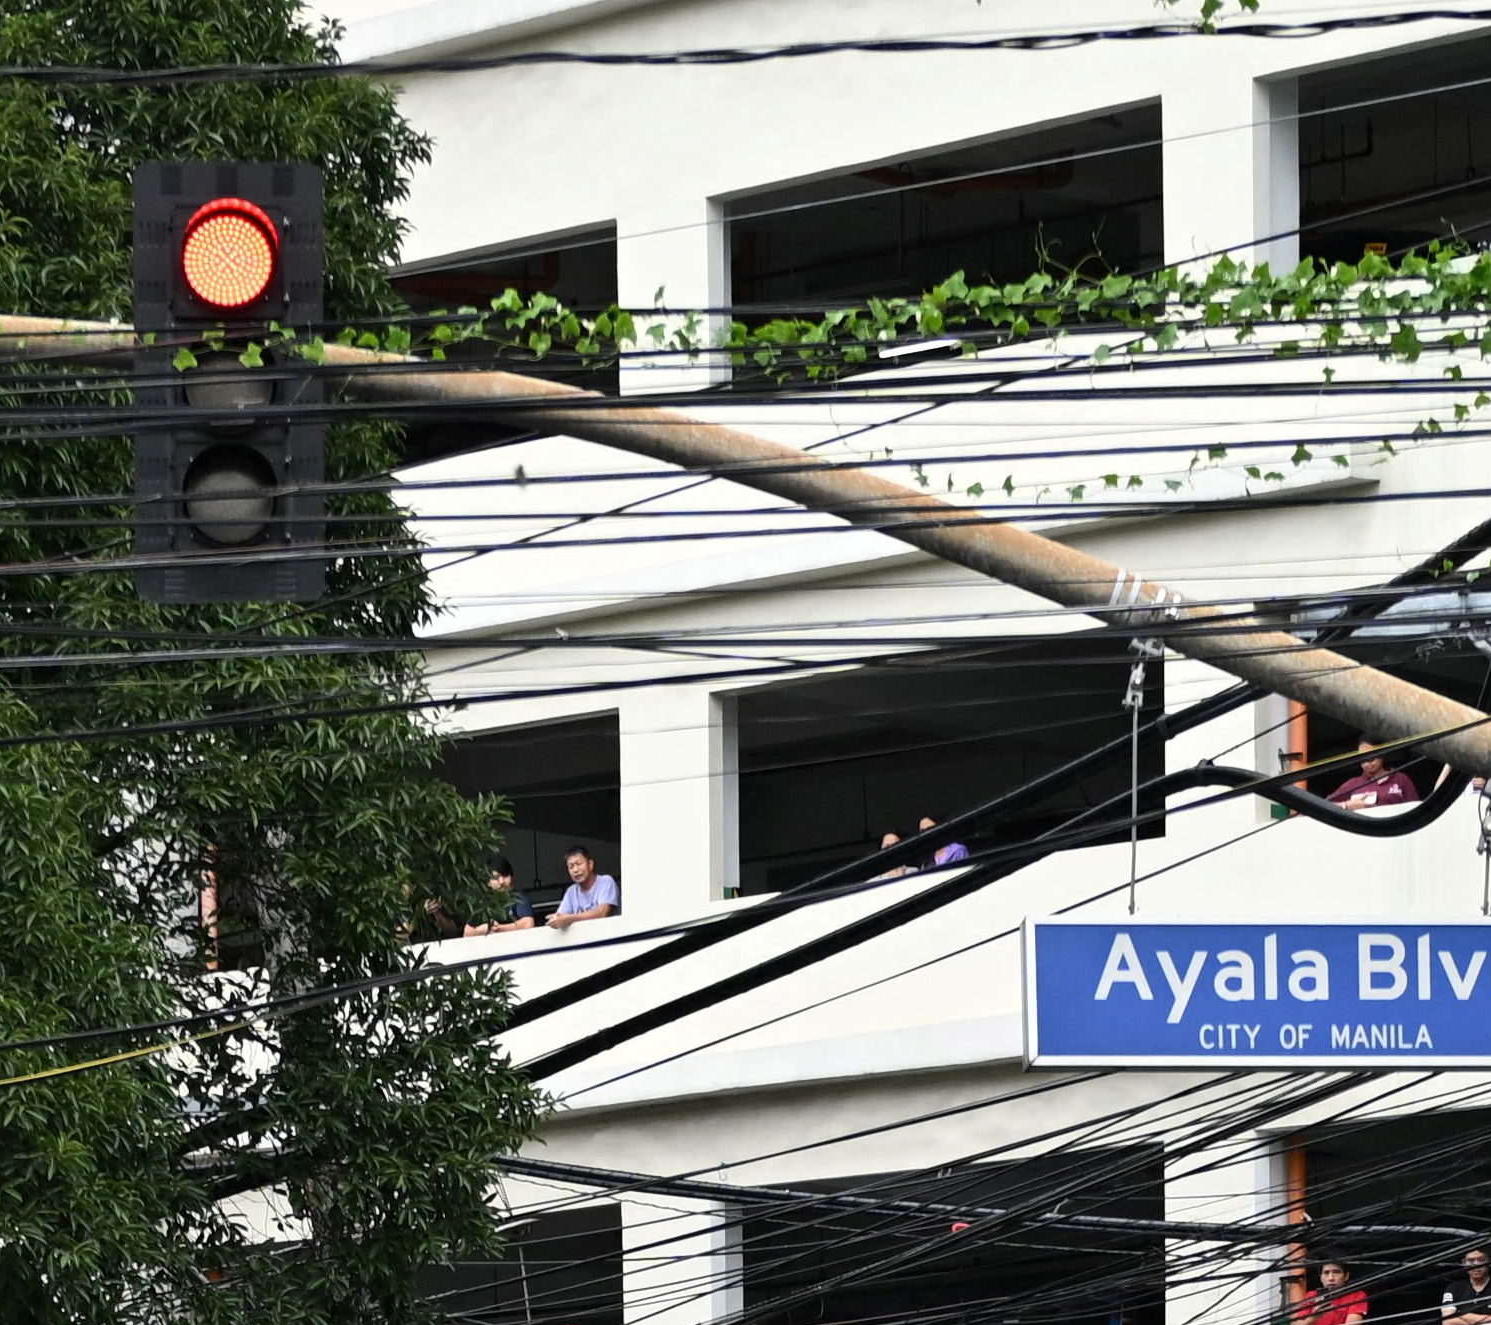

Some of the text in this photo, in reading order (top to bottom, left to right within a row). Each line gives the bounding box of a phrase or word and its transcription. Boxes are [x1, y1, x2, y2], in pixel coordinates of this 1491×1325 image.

[1094, 932, 1330, 1024] Ayala
[1199, 1023, 1434, 1051] CITY OF MANILA
